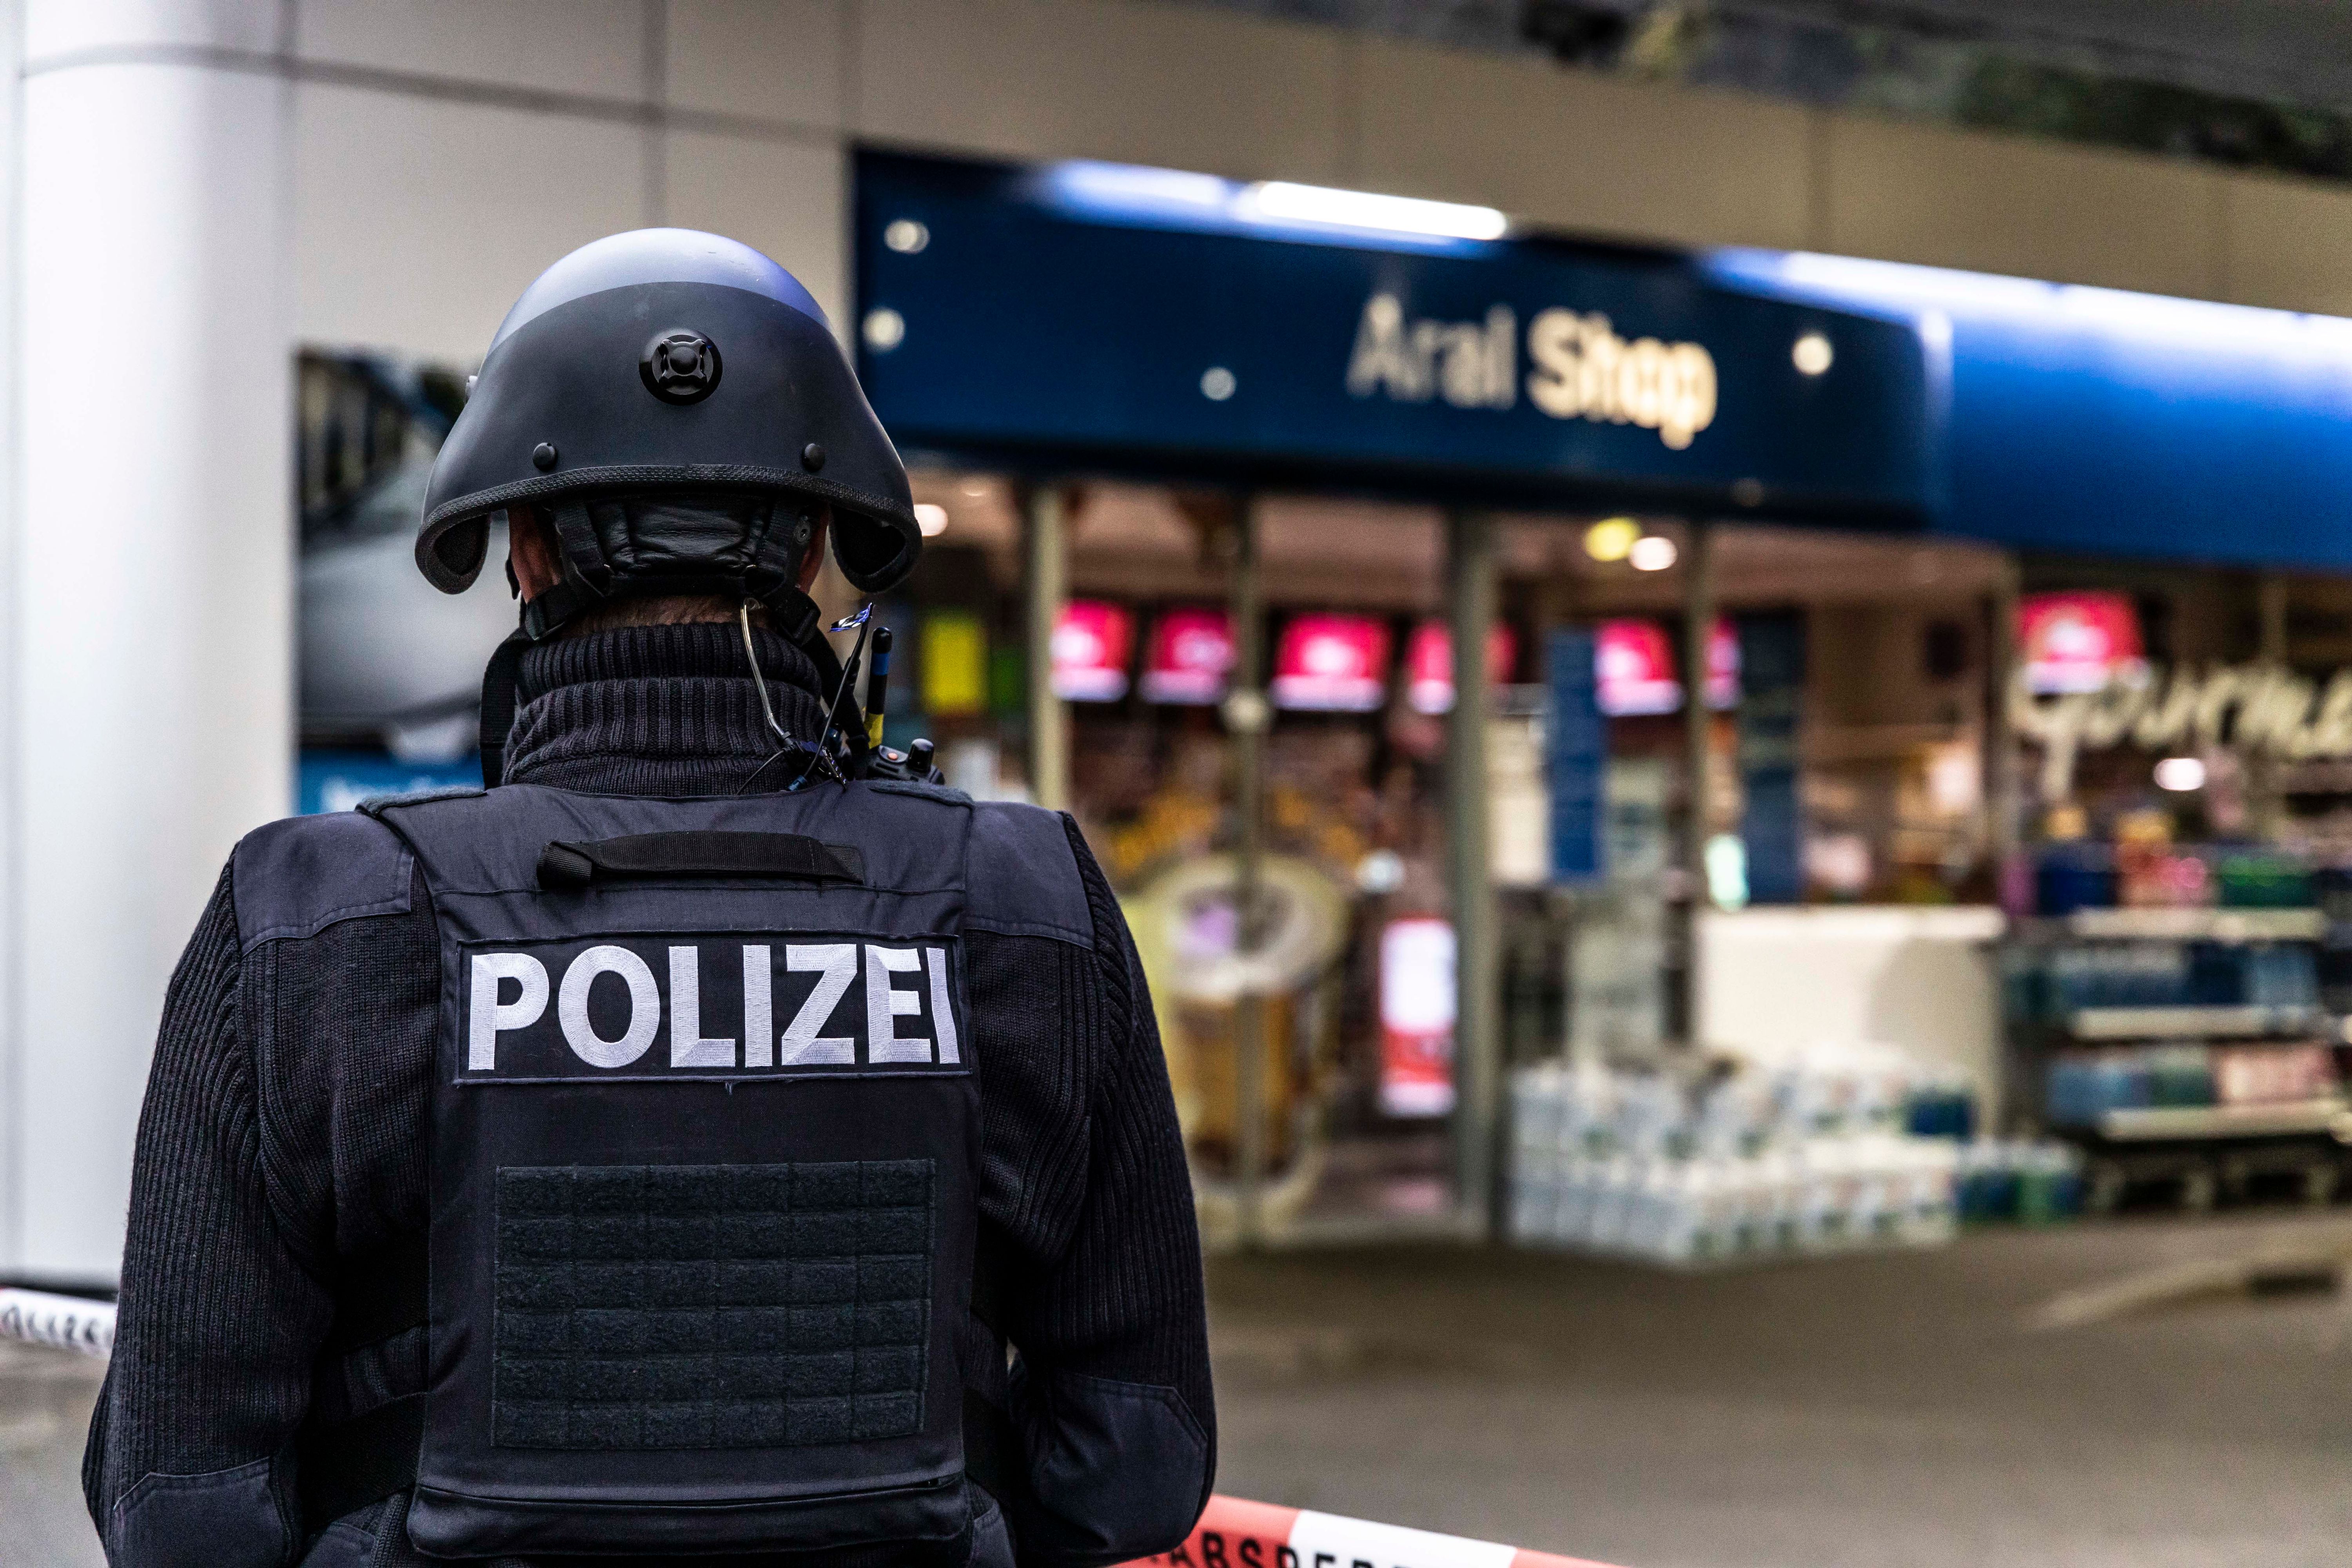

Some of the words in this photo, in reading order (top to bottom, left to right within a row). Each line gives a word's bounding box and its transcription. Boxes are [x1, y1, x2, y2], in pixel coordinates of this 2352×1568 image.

[1347, 291, 1515, 410] Aral
[1528, 307, 1717, 450] Shop
[468, 944, 959, 1070] POLIZEI
